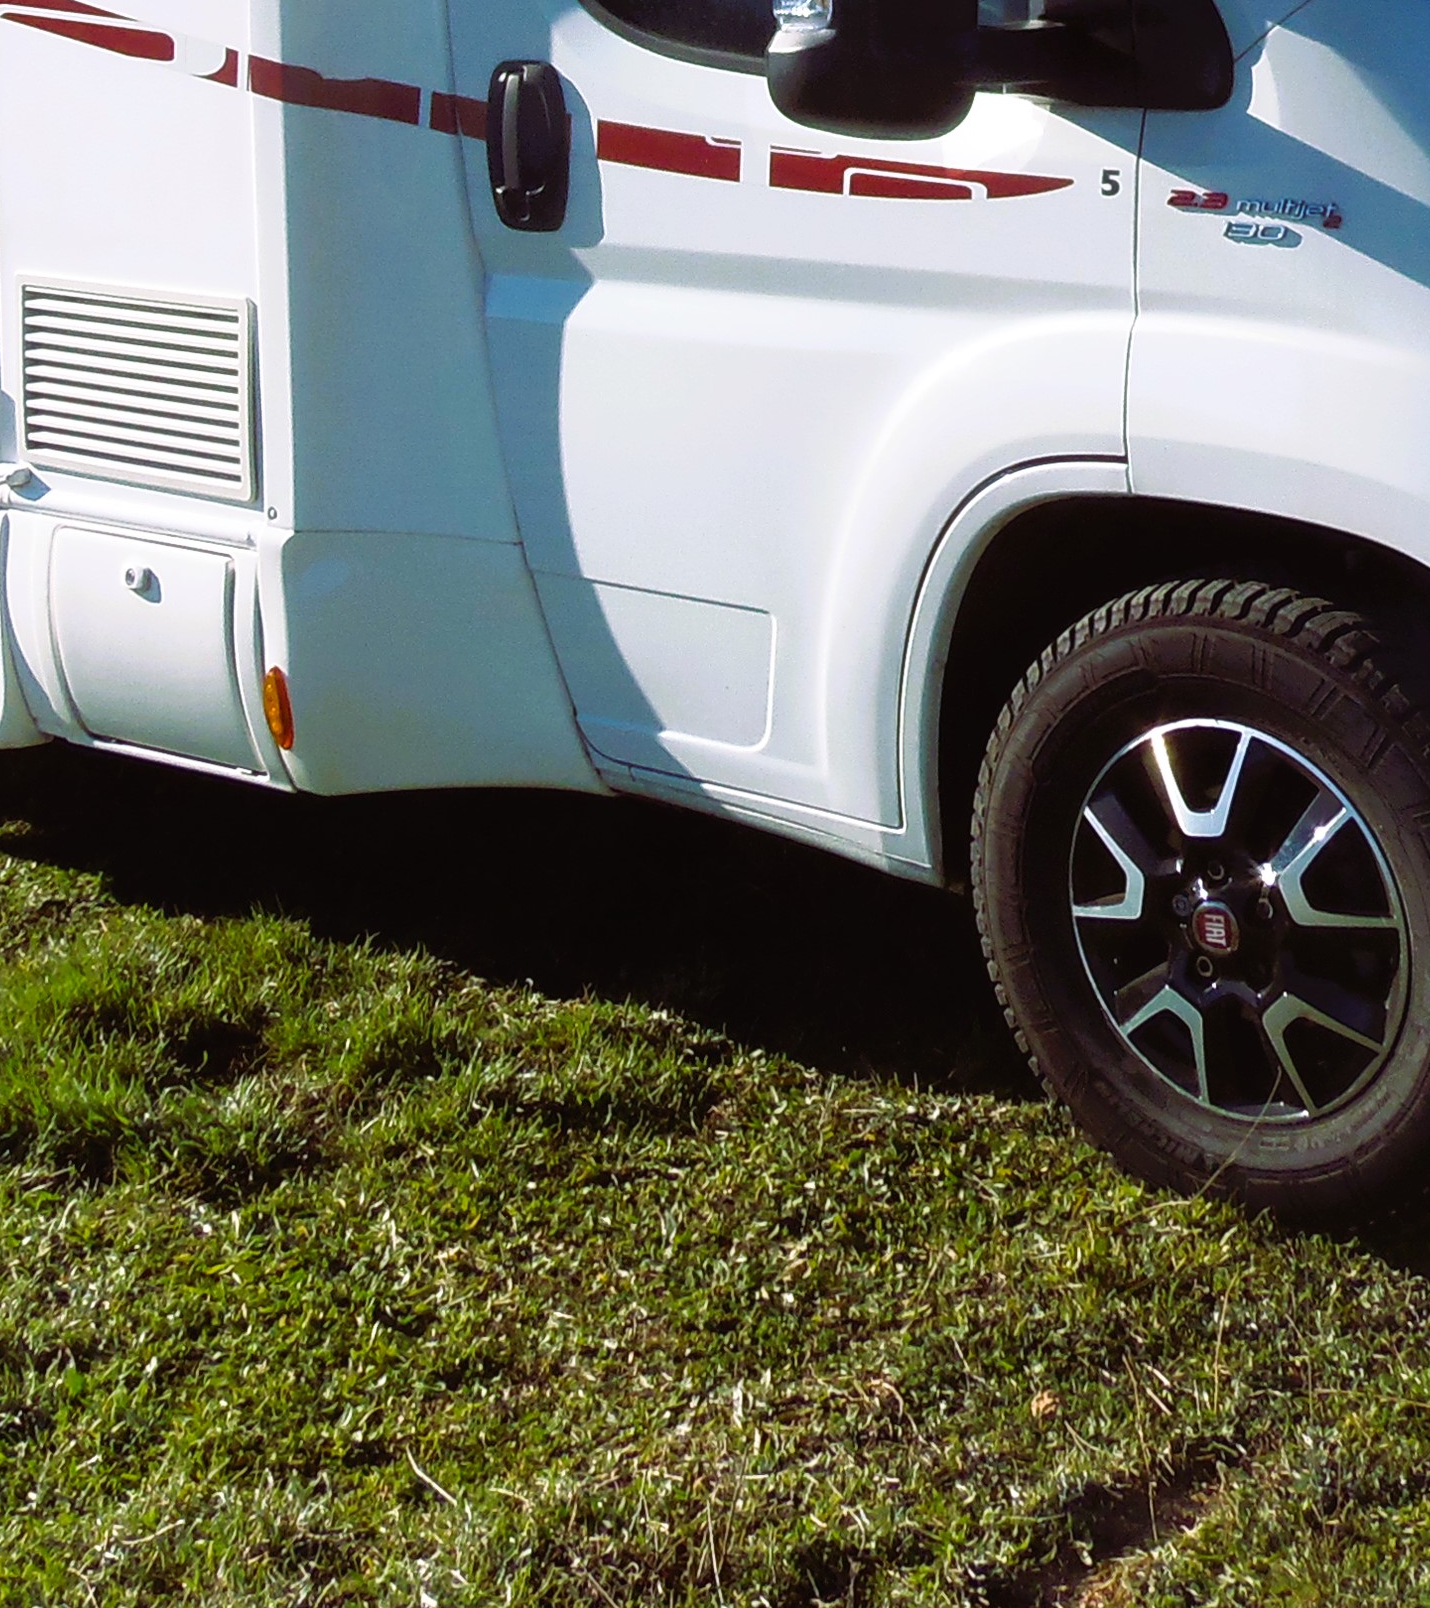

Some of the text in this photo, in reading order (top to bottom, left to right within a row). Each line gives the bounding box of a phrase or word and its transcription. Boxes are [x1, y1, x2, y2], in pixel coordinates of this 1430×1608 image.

[1100, 169, 1121, 197] 5
[1167, 189, 1229, 210] 2.3
[1235, 198, 1335, 220] multijet
[1203, 913, 1227, 947] FIAT
